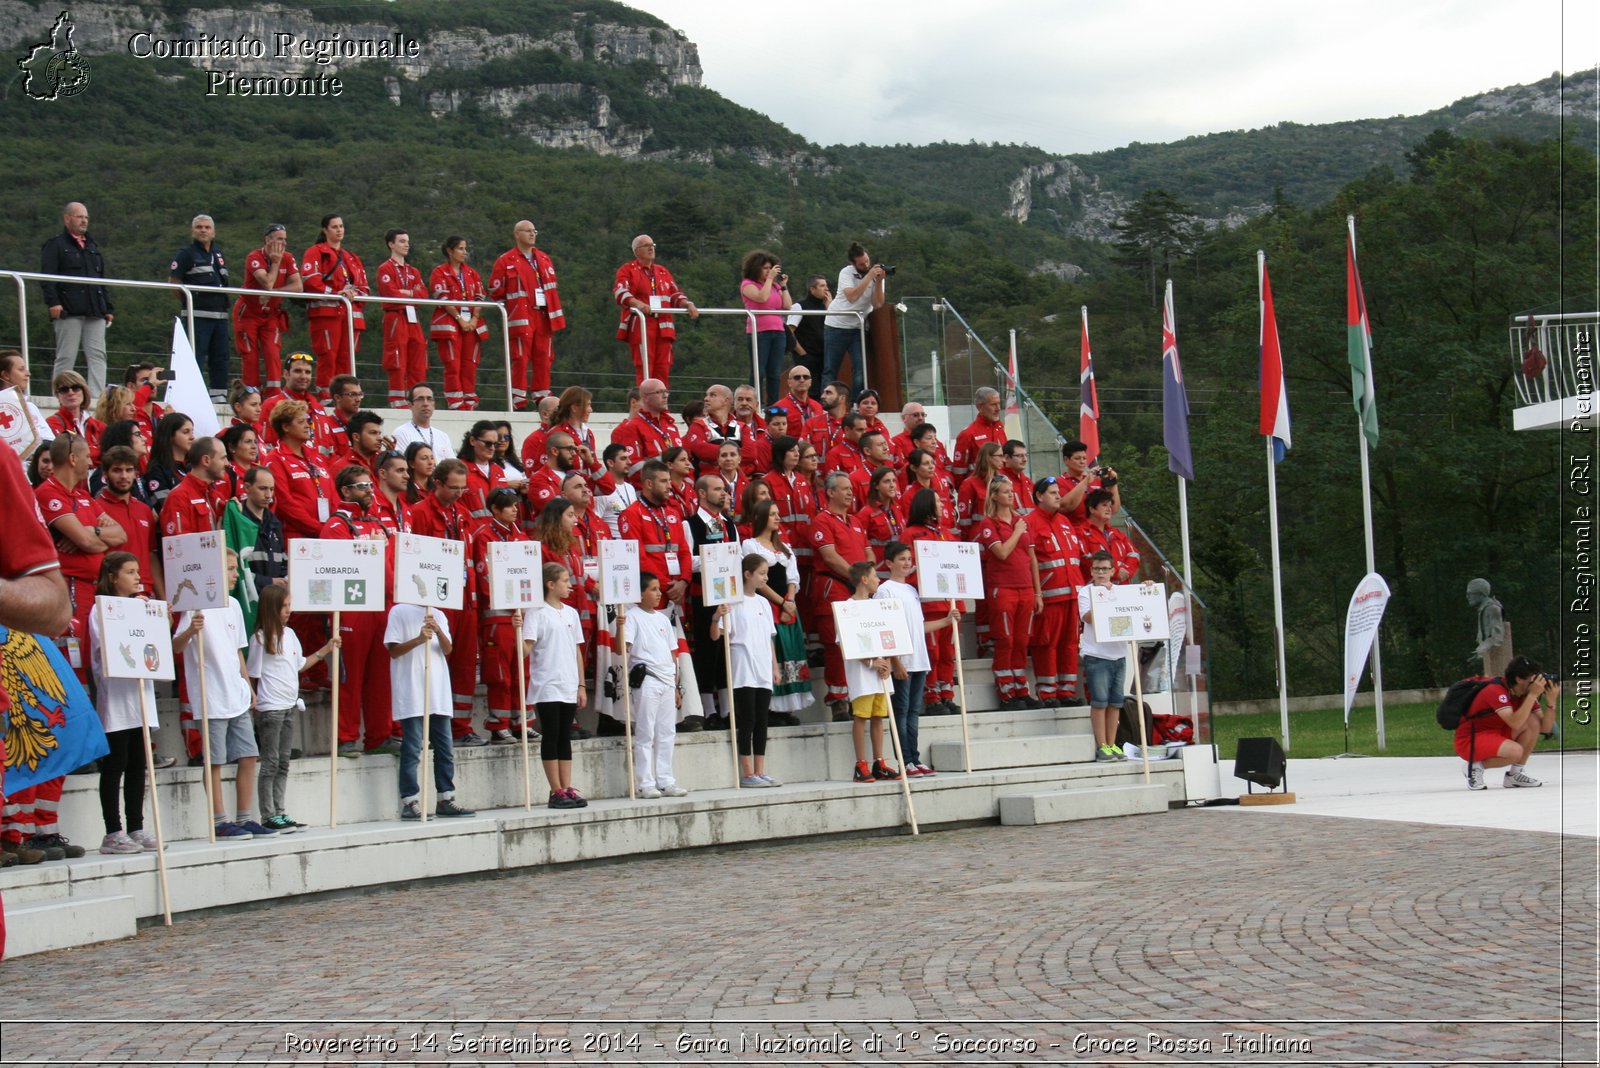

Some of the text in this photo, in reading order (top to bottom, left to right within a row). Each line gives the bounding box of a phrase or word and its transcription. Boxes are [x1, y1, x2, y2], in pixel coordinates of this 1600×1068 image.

[182, 563, 202, 573] LIGURIA
[315, 567, 360, 575] LOMBARDIA
[419, 562, 442, 572] MARCHE
[507, 567, 528, 575] PIEMONTE
[1115, 605, 1144, 613] TRENTINO
[859, 621, 886, 629] TOSCANA
[129, 629, 145, 638] LAZIO
